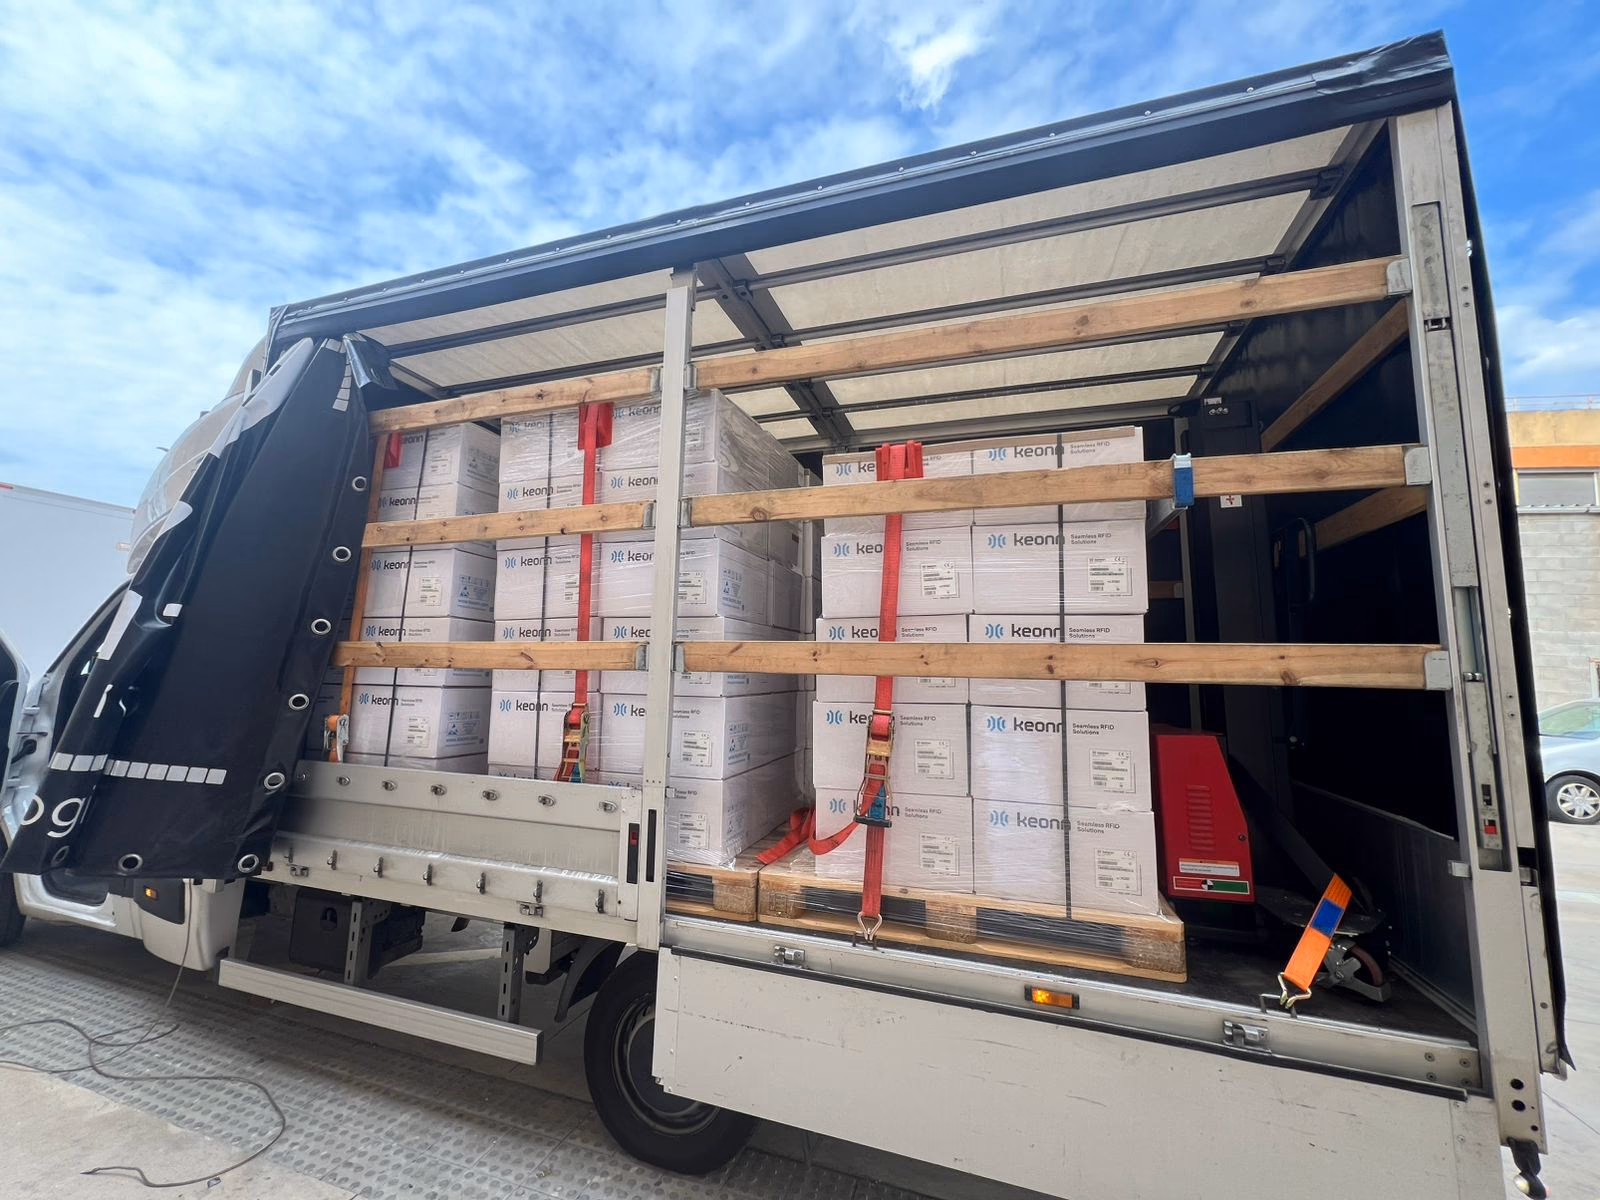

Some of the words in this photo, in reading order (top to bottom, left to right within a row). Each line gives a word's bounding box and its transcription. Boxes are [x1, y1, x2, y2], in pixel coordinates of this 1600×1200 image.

[628, 476, 658, 487] keon
[389, 496, 417, 506] keonn
[856, 542, 883, 555] keo
[630, 626, 651, 638] keo
[851, 625, 878, 639] keo
[1077, 820, 1105, 828] Seamless
[1105, 822, 1121, 830] RFID
[1077, 826, 1105, 834] Solutions
